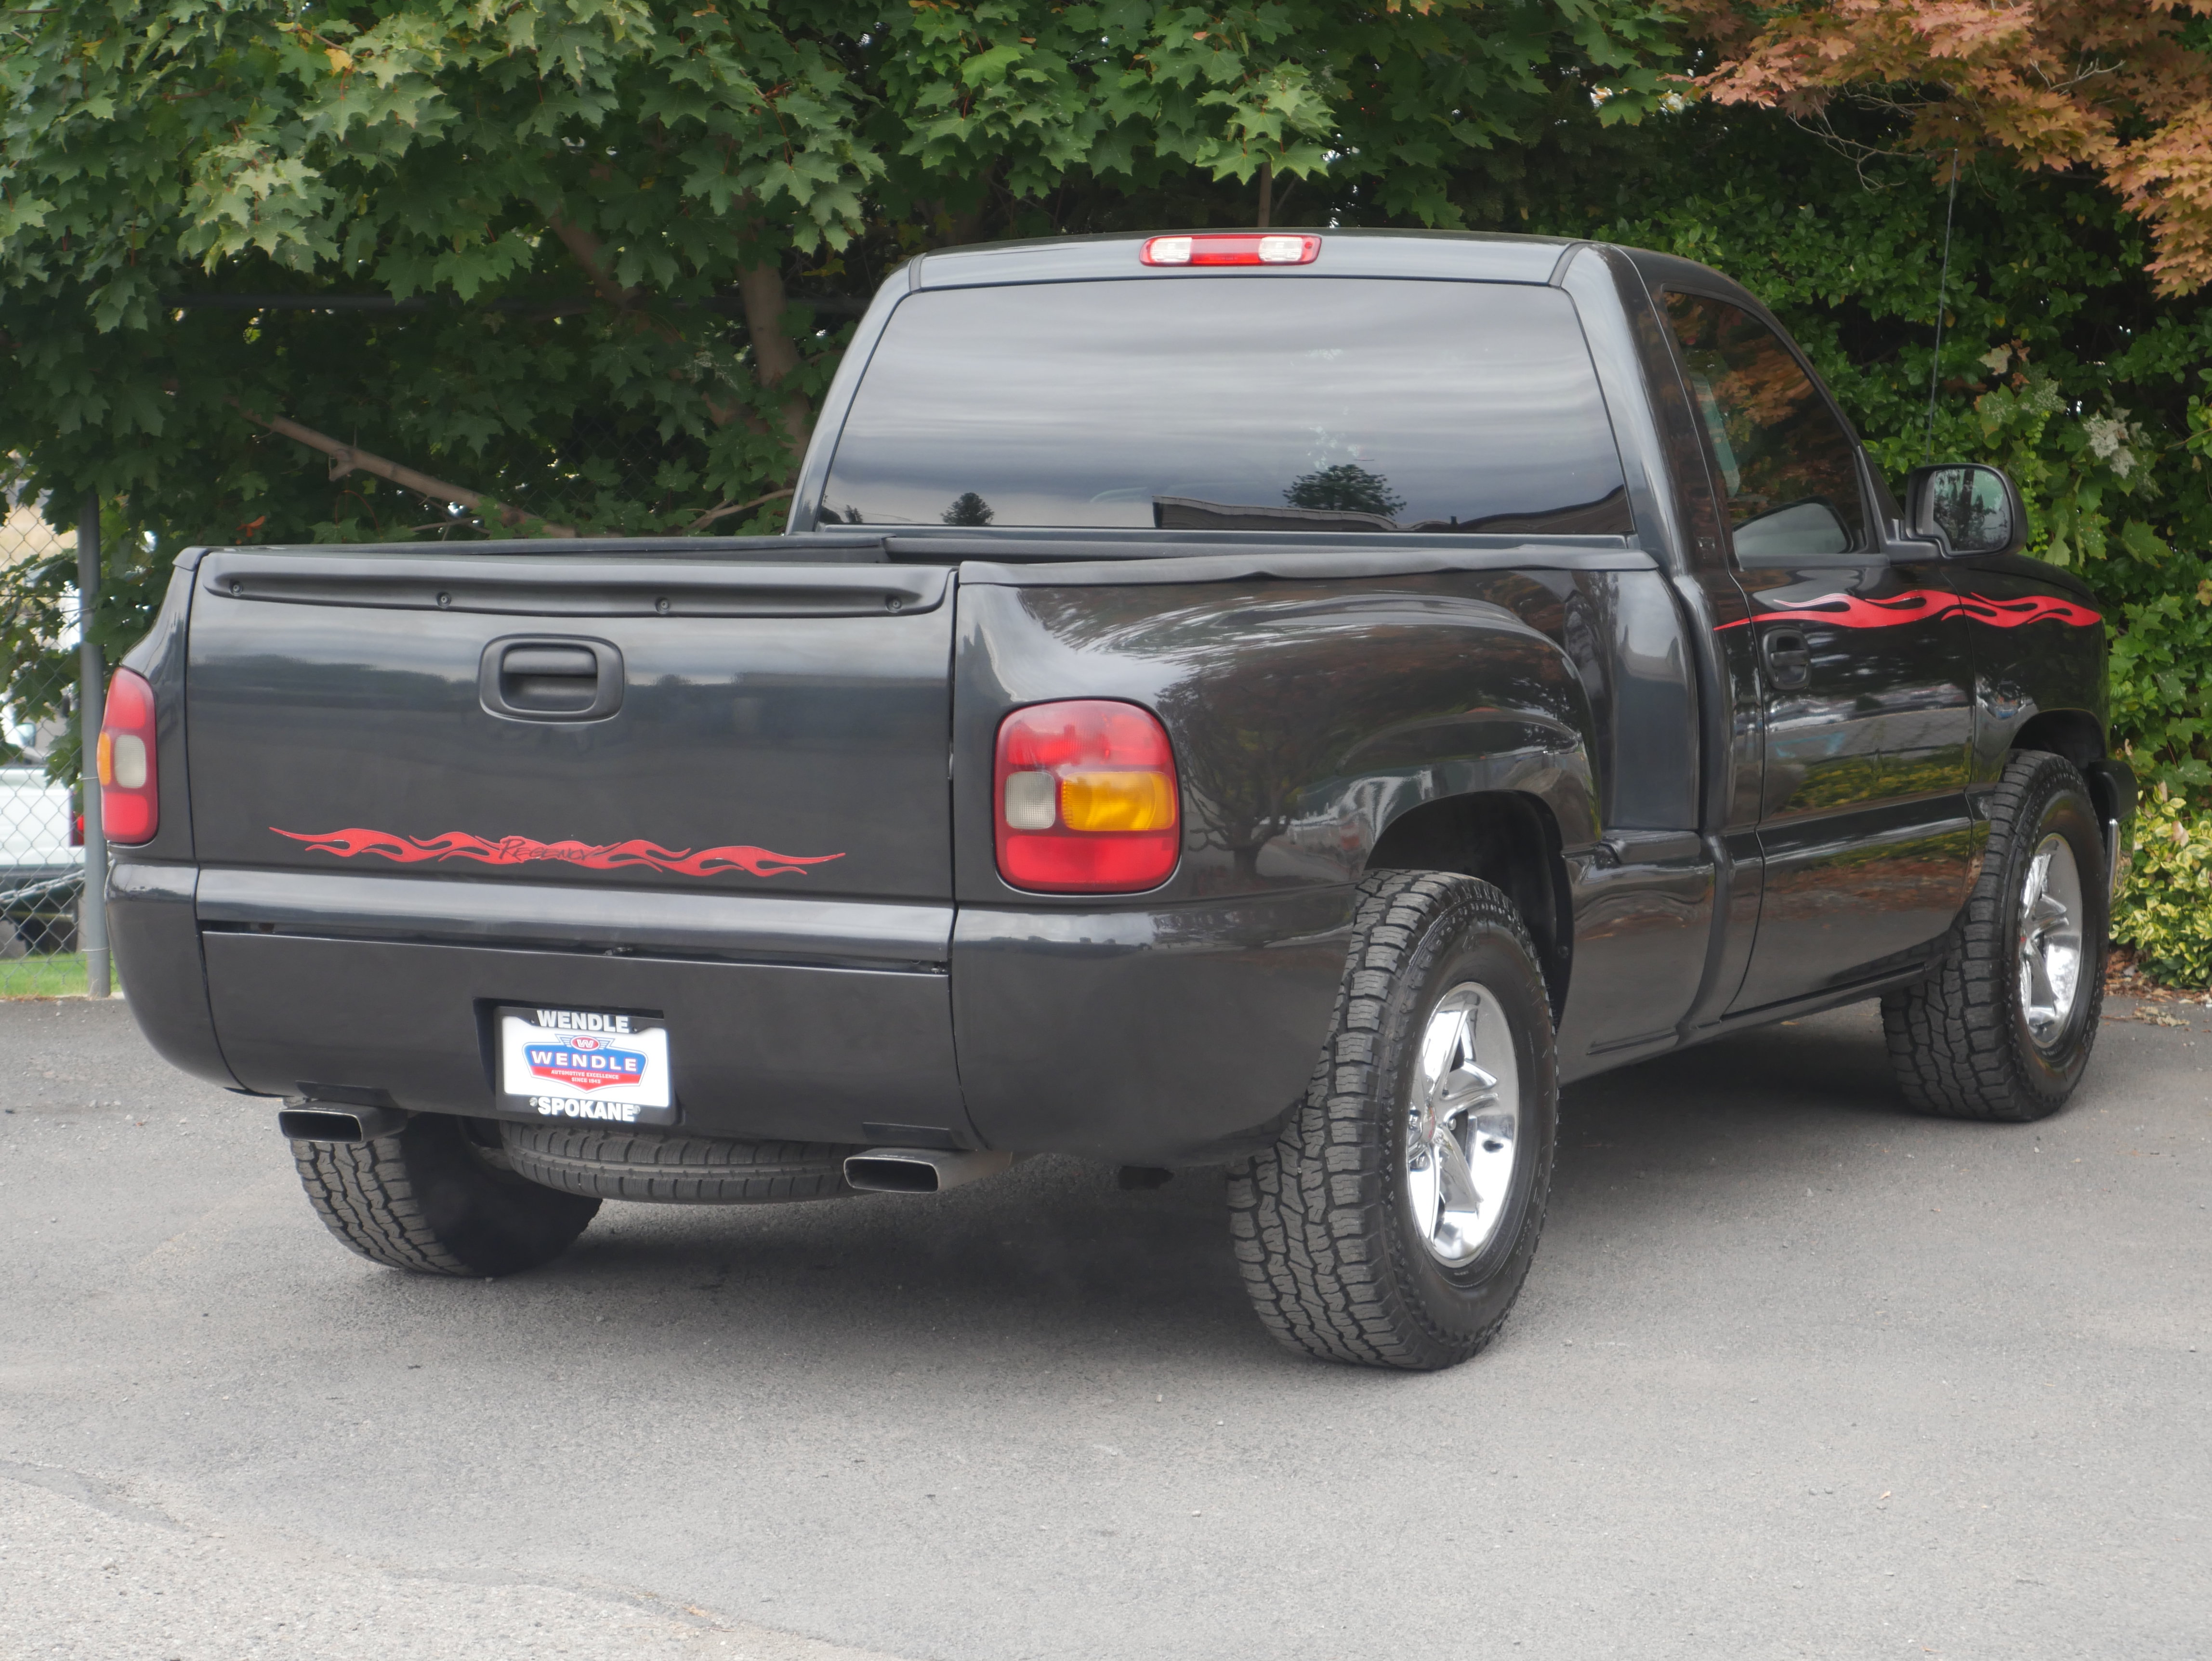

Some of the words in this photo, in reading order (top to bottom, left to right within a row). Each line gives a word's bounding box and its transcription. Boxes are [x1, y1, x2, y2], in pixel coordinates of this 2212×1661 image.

[537, 1010, 630, 1033] WENDLE
[577, 1039, 594, 1048] W
[532, 1051, 637, 1071] WENDLE
[538, 1096, 635, 1122] SPOKANE
